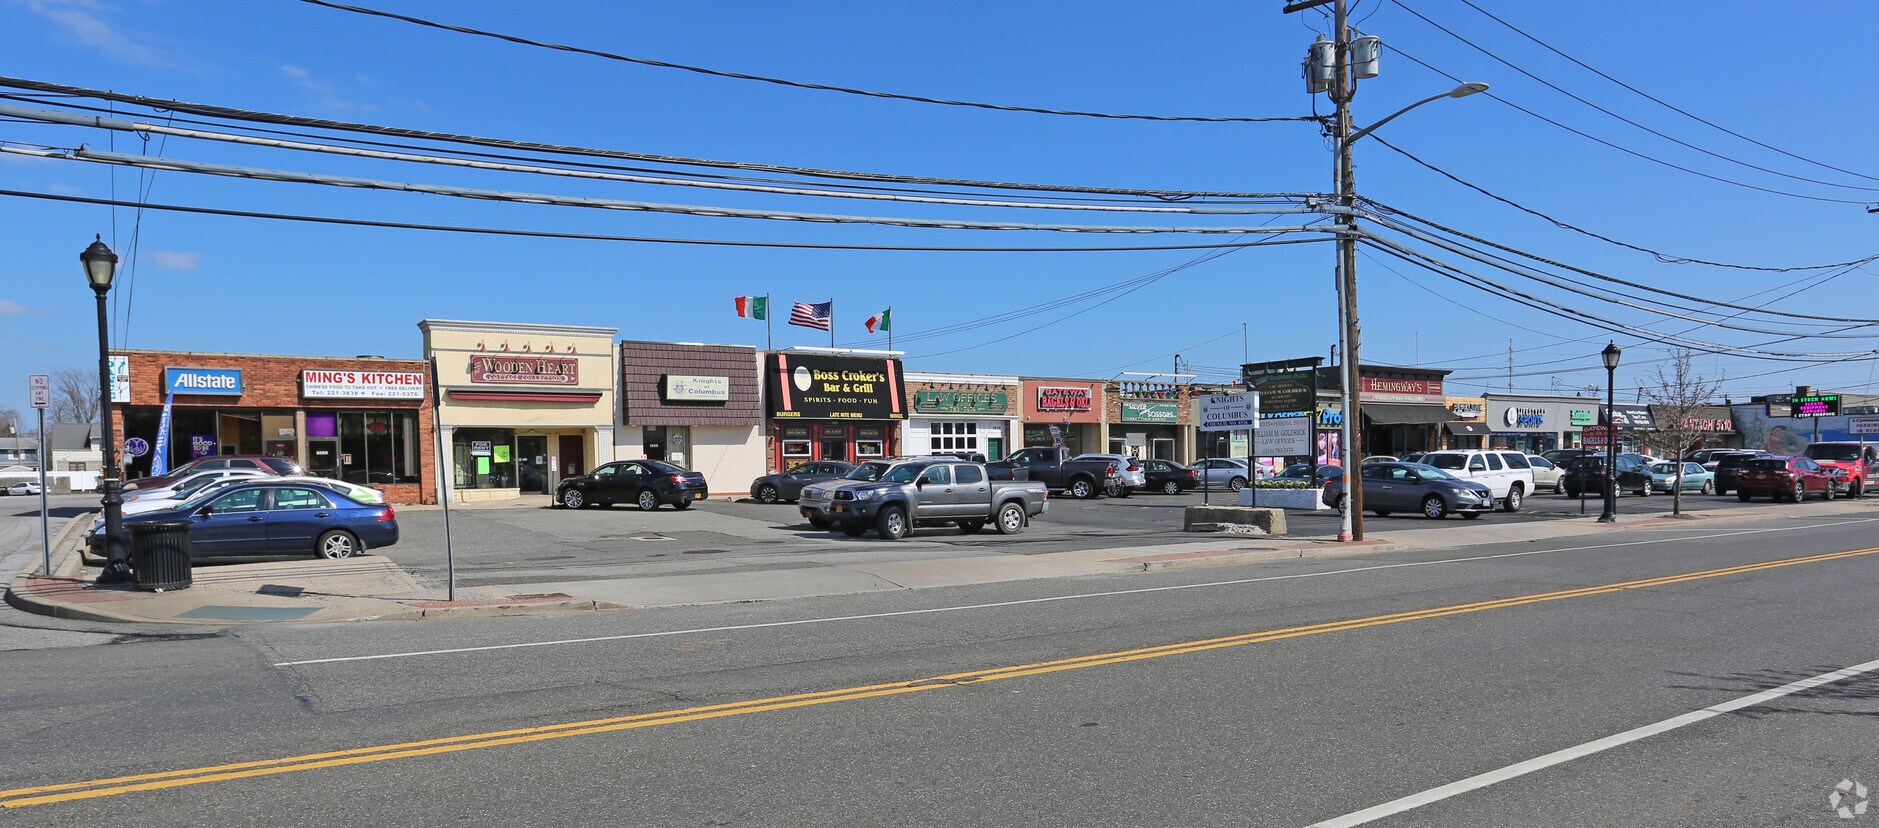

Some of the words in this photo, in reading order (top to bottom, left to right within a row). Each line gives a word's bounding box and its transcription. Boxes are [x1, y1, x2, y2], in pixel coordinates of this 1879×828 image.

[482, 358, 532, 373] WOODEN
[536, 360, 575, 374] HEART
[174, 373, 236, 389] Allstate
[305, 372, 356, 384] MING'S
[362, 373, 422, 384] KITCHEN
[814, 370, 839, 380] Boss
[842, 370, 886, 382] Croker's
[824, 383, 840, 392] Bar
[843, 384, 850, 392] &
[853, 384, 873, 393] Grill
[1371, 378, 1422, 392] HEMINGWAY'S
[927, 392, 950, 402] LAW
[953, 393, 997, 403] OFFICES
[1042, 396, 1068, 407] BAGELS
[1077, 398, 1092, 408] DELI
[1453, 404, 1482, 412] PIPELINE
[1207, 412, 1248, 420] COLUMBUS
[1323, 409, 1342, 424] Pro
[1520, 416, 1543, 425] SPORTS
